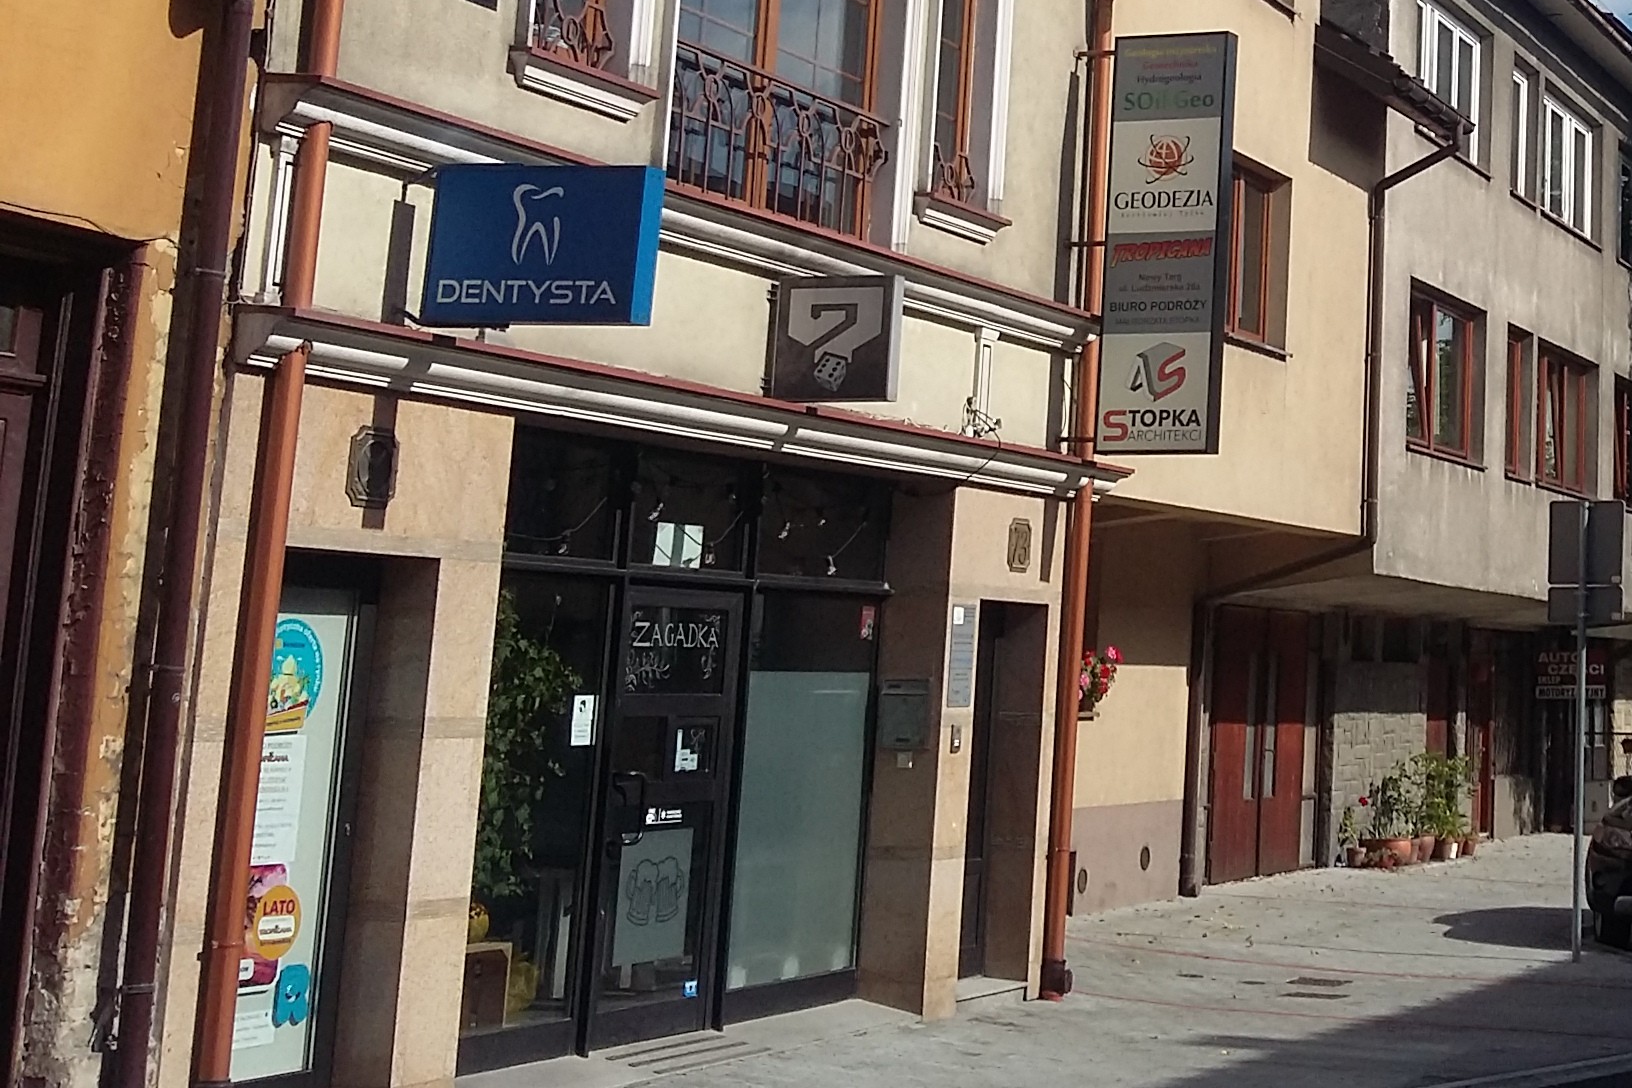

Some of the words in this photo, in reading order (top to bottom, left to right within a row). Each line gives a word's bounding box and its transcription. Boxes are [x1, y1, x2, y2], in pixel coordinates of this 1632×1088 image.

[1137, 72, 1202, 86] Hydrogeologia
[1174, 89, 1215, 109] Geo
[1114, 189, 1213, 210] GEODEZJA
[1110, 237, 1213, 269] TROPICANA
[435, 278, 617, 306] DENTYSTA
[1109, 301, 1147, 313] BIURO
[1103, 409, 1201, 441] STOPKA
[1127, 428, 1202, 442] ARCHITEKCI
[632, 621, 720, 649] ZAGADKA
[1537, 675, 1561, 684] SKLEP
[1538, 687, 1605, 698] MOTORYZYJNY
[262, 899, 296, 916] LATO
